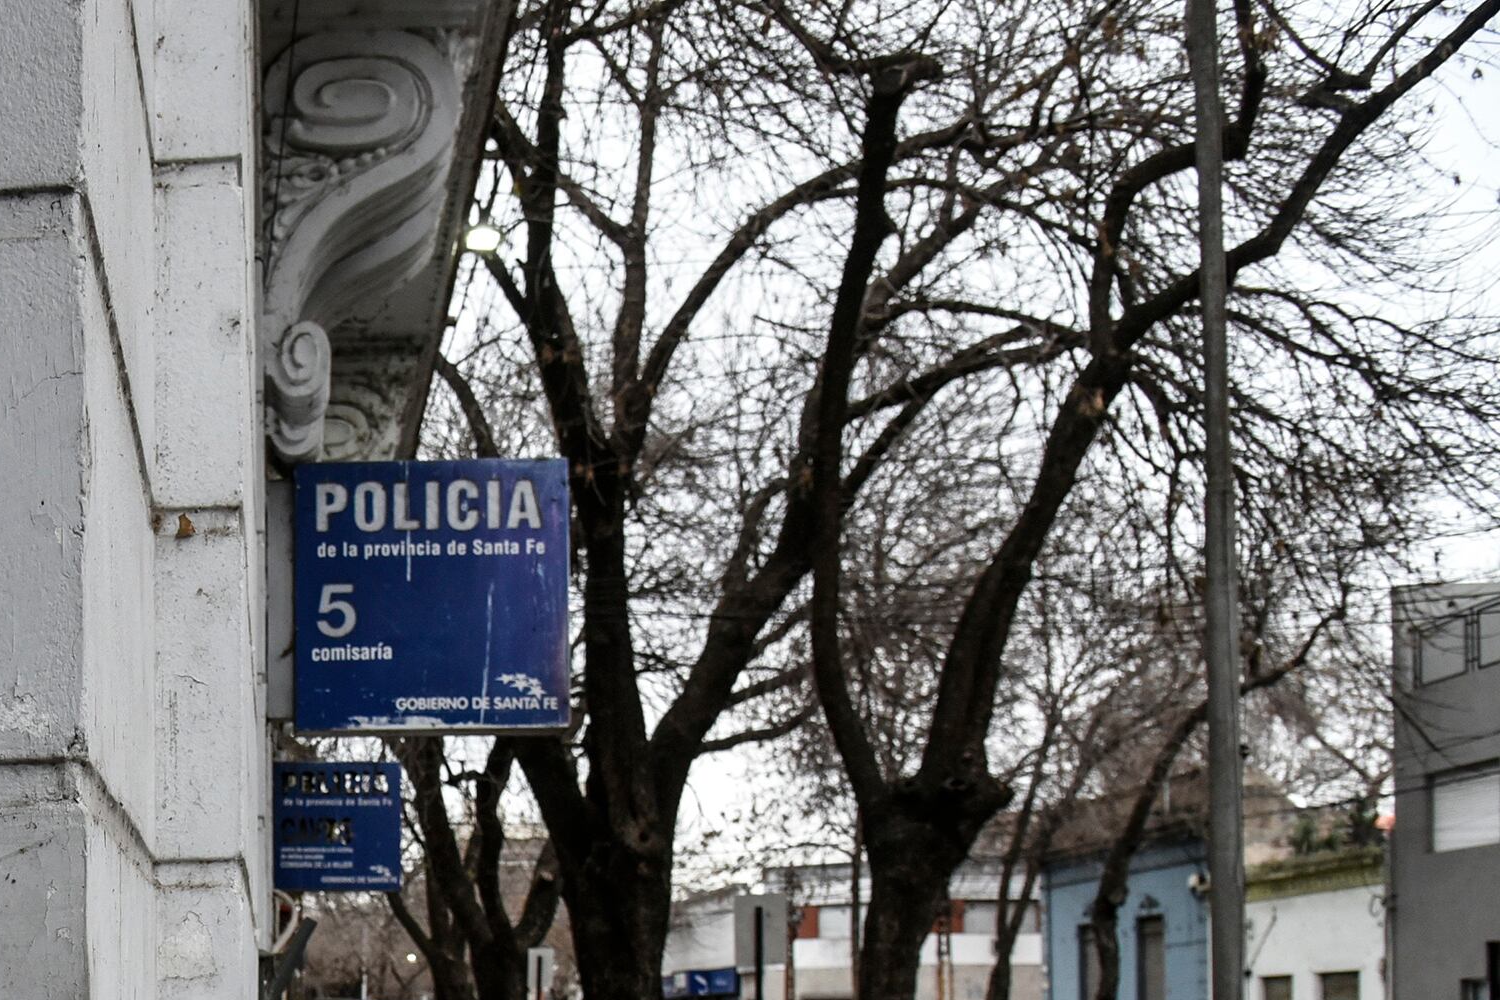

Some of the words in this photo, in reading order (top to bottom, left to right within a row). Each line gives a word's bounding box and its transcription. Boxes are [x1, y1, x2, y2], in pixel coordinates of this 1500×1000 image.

[316, 479, 542, 532] POLICIA
[317, 542, 337, 558] de
[343, 541, 358, 558] la
[364, 540, 441, 560] provincia
[447, 540, 467, 556] de
[472, 538, 520, 556] Santa
[526, 538, 546, 555] Fe
[316, 583, 357, 638] 5
[311, 642, 393, 662] comisaría
[395, 697, 469, 711] GOBIERNO
[472, 697, 490, 710] DE
[493, 696, 541, 711] SANTA
[543, 696, 559, 710] FE
